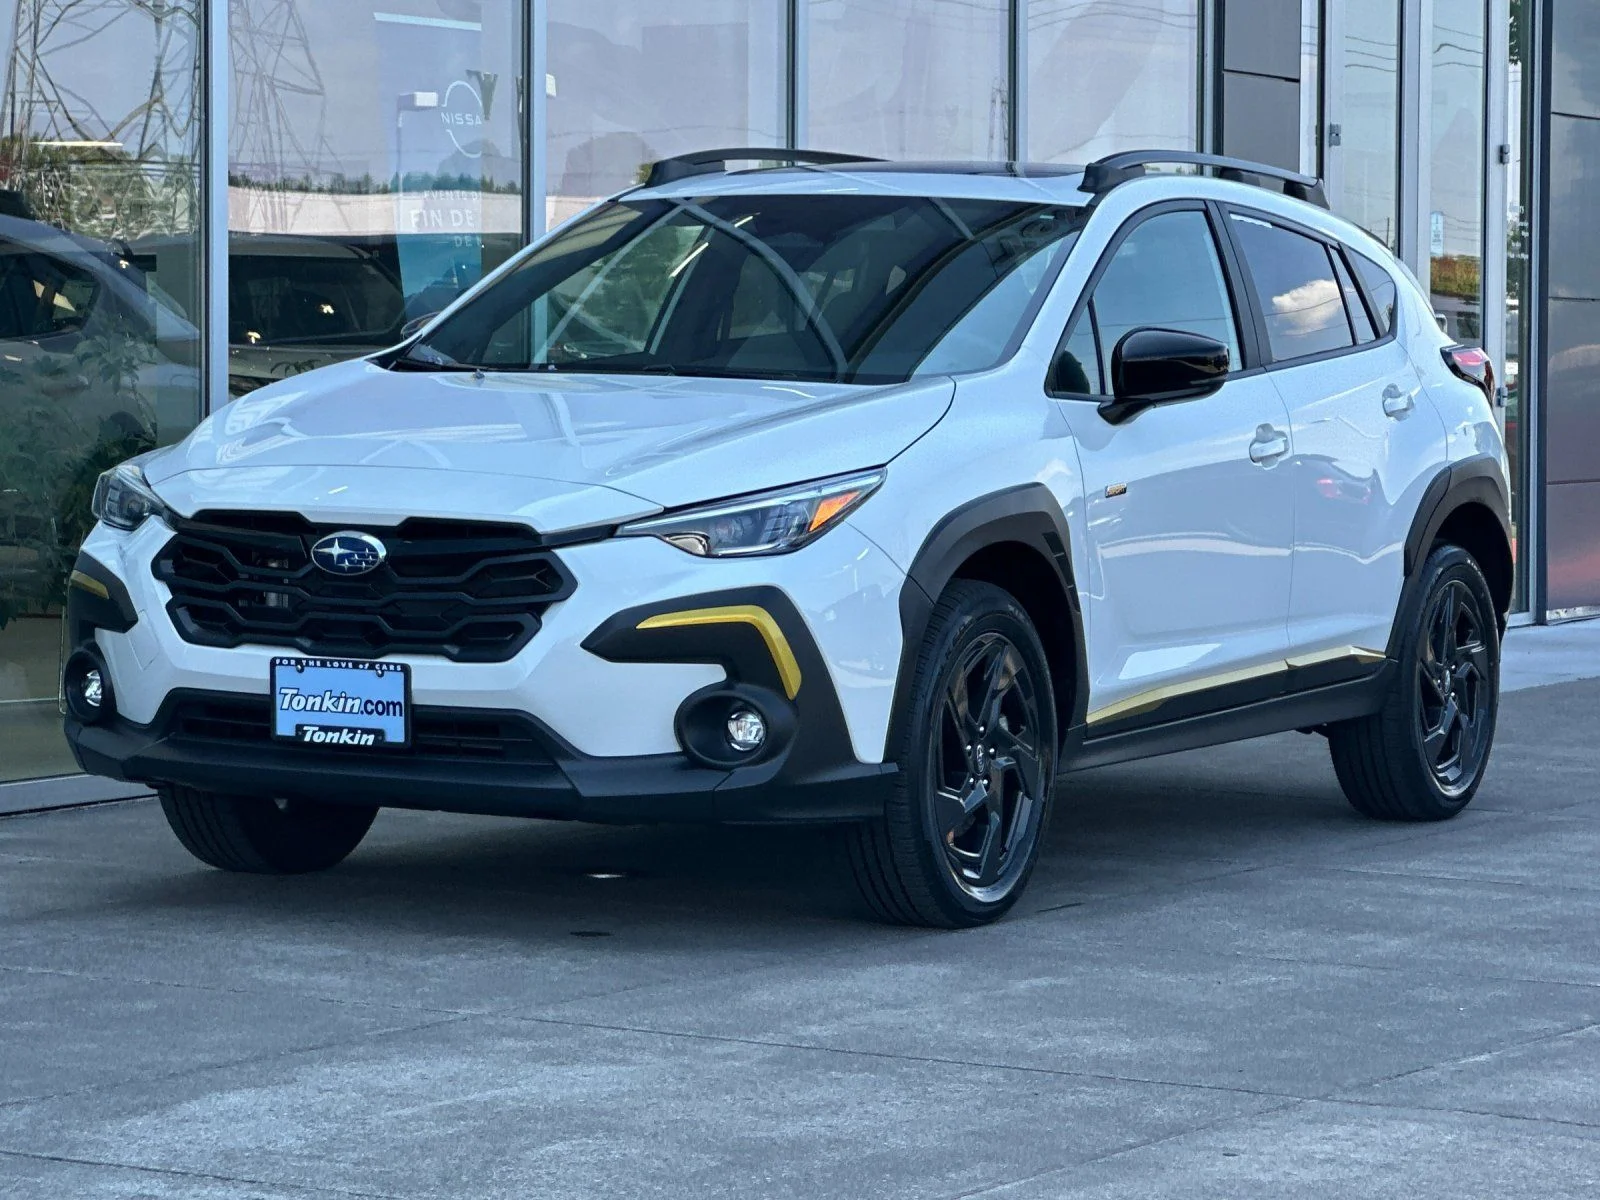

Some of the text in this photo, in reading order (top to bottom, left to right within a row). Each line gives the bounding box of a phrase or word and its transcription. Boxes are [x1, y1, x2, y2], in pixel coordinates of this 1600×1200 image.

[410, 208, 475, 228] FIN DE
[275, 658, 296, 666] FOR
[302, 659, 321, 667] THE
[326, 661, 353, 669] LOVE
[375, 664, 402, 672] CARS
[279, 687, 403, 717] Tonkin.com
[302, 725, 375, 746] Tonkin
